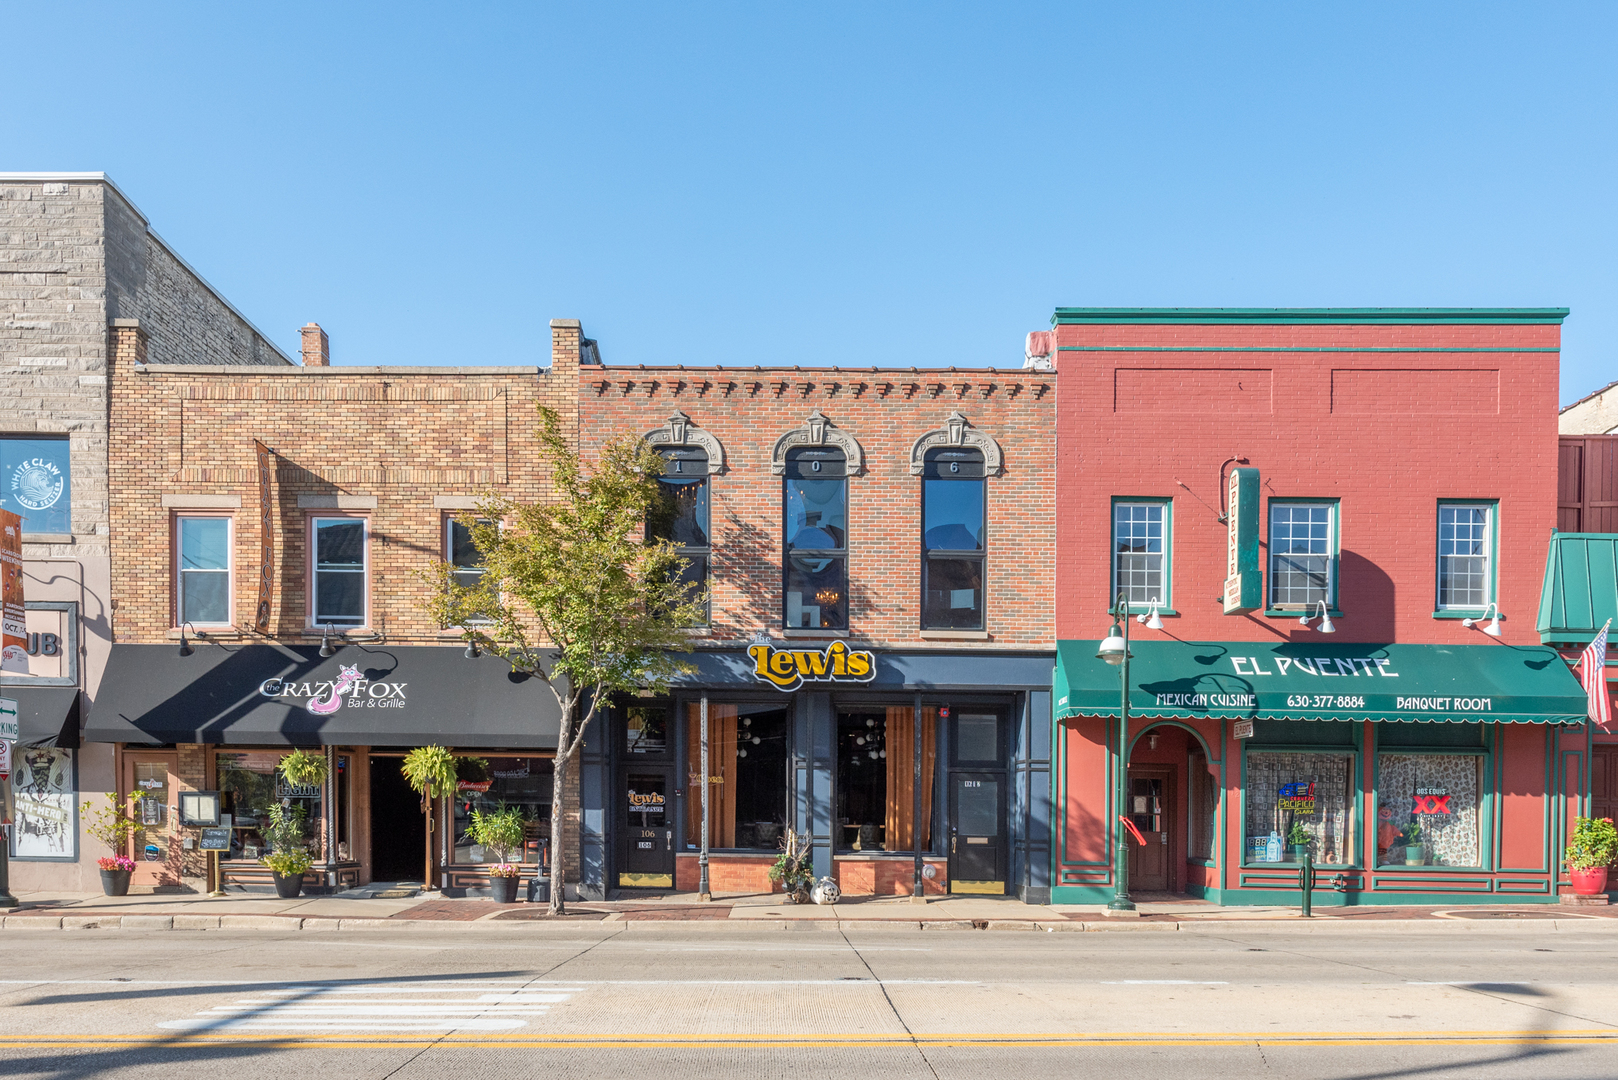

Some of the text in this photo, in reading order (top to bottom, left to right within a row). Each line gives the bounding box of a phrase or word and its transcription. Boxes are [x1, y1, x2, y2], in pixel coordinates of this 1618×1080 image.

[950, 461, 958, 472] 6
[10, 457, 61, 491] WHITE CLAW
[19, 482, 61, 507] HARD SELTZER
[259, 451, 273, 599] CRAZY FOX
[750, 633, 771, 643] The
[749, 641, 870, 686] Lewis
[1229, 656, 1399, 677] EL PUENTE
[259, 676, 408, 705] CRAZY FOX
[266, 684, 281, 692] the
[347, 698, 406, 709] Bar & Grille
[1156, 693, 1256, 707] MEXICAN CUISINE
[1396, 696, 1492, 710] BANQUET ROOM
[0, 722, 18, 736] KING
[457, 781, 490, 789] Budweiser
[628, 792, 665, 806] Lewis
[1278, 798, 1315, 809] PACIFICO
[1412, 795, 1451, 814] XX
[15, 800, 62, 820] ANTI-HERO
[641, 830, 655, 838] 106
